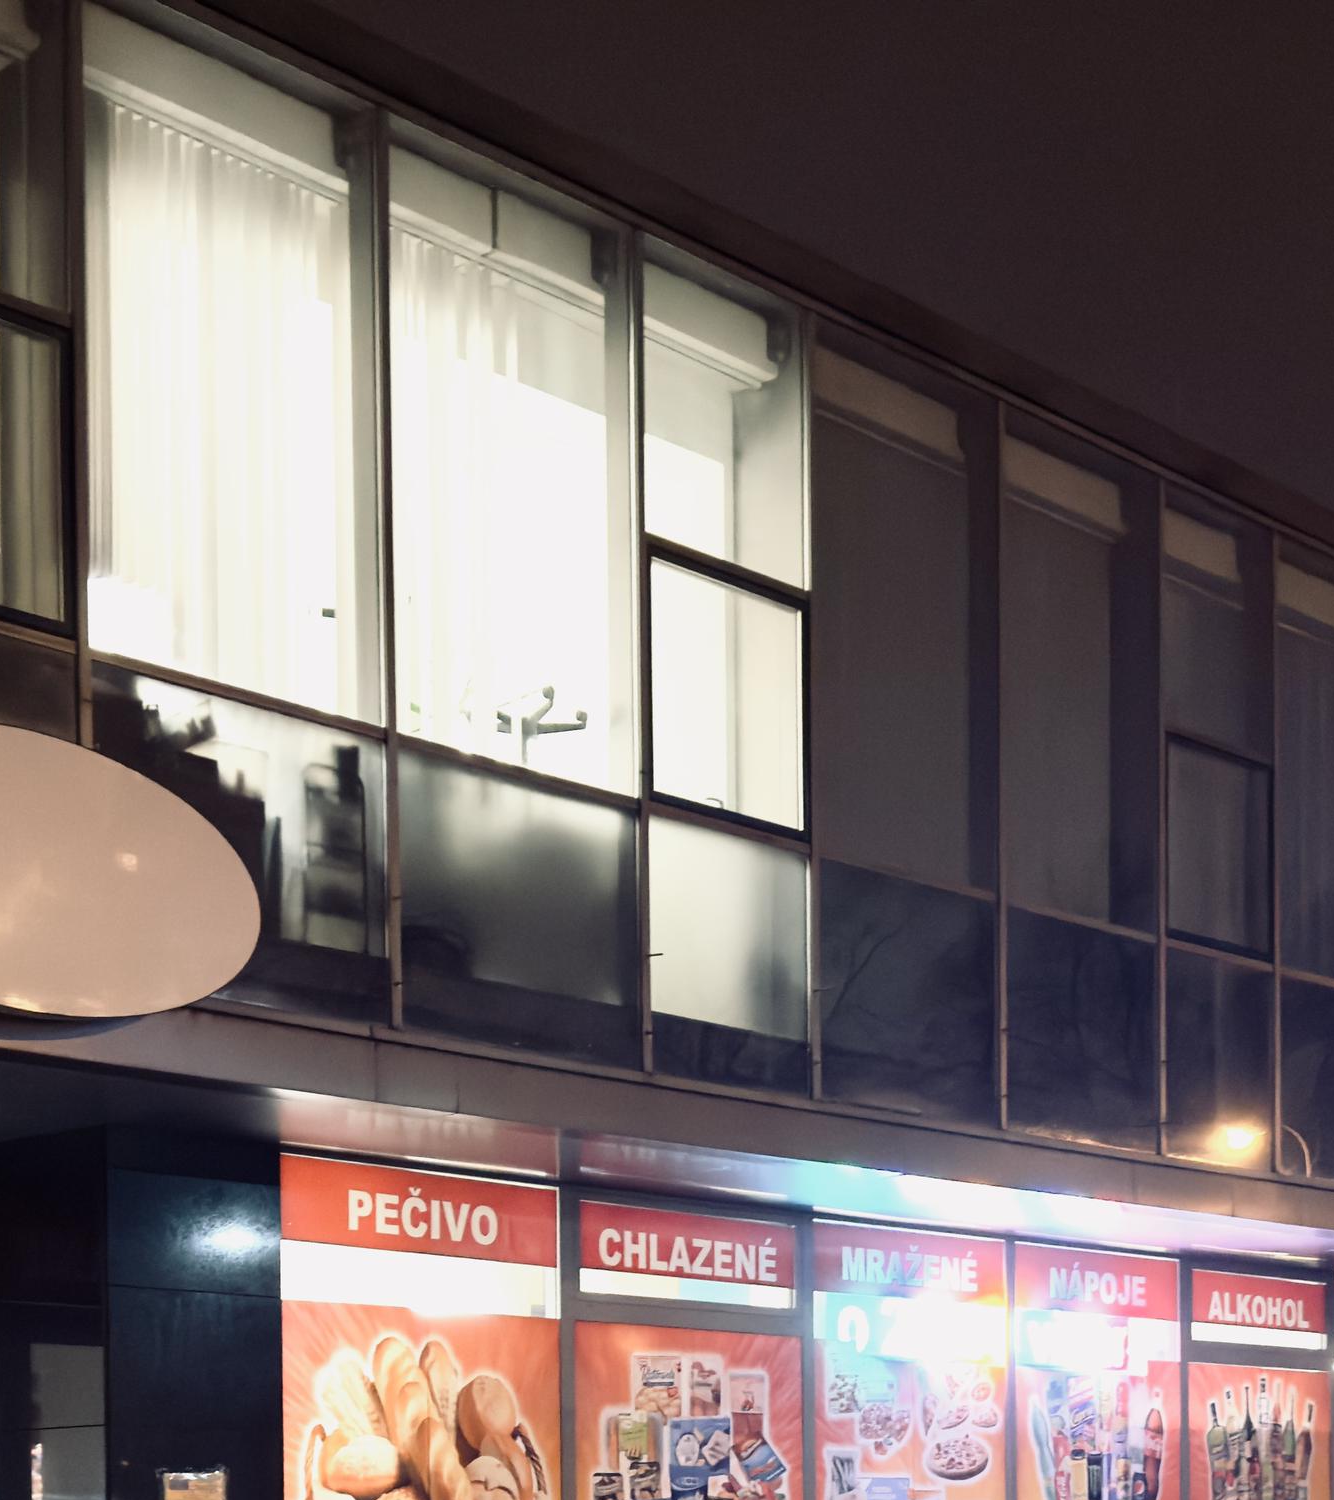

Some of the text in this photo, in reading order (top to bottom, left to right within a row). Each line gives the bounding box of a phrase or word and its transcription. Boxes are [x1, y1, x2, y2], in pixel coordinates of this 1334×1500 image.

[348, 1187, 498, 1245] PEČIVO
[599, 1228, 777, 1282] CHLAZENÉ
[842, 1245, 978, 1292] MRAŽENÉ
[1049, 1262, 1147, 1307] NÁPOJE
[1208, 1291, 1309, 1328] ALKOHOL
